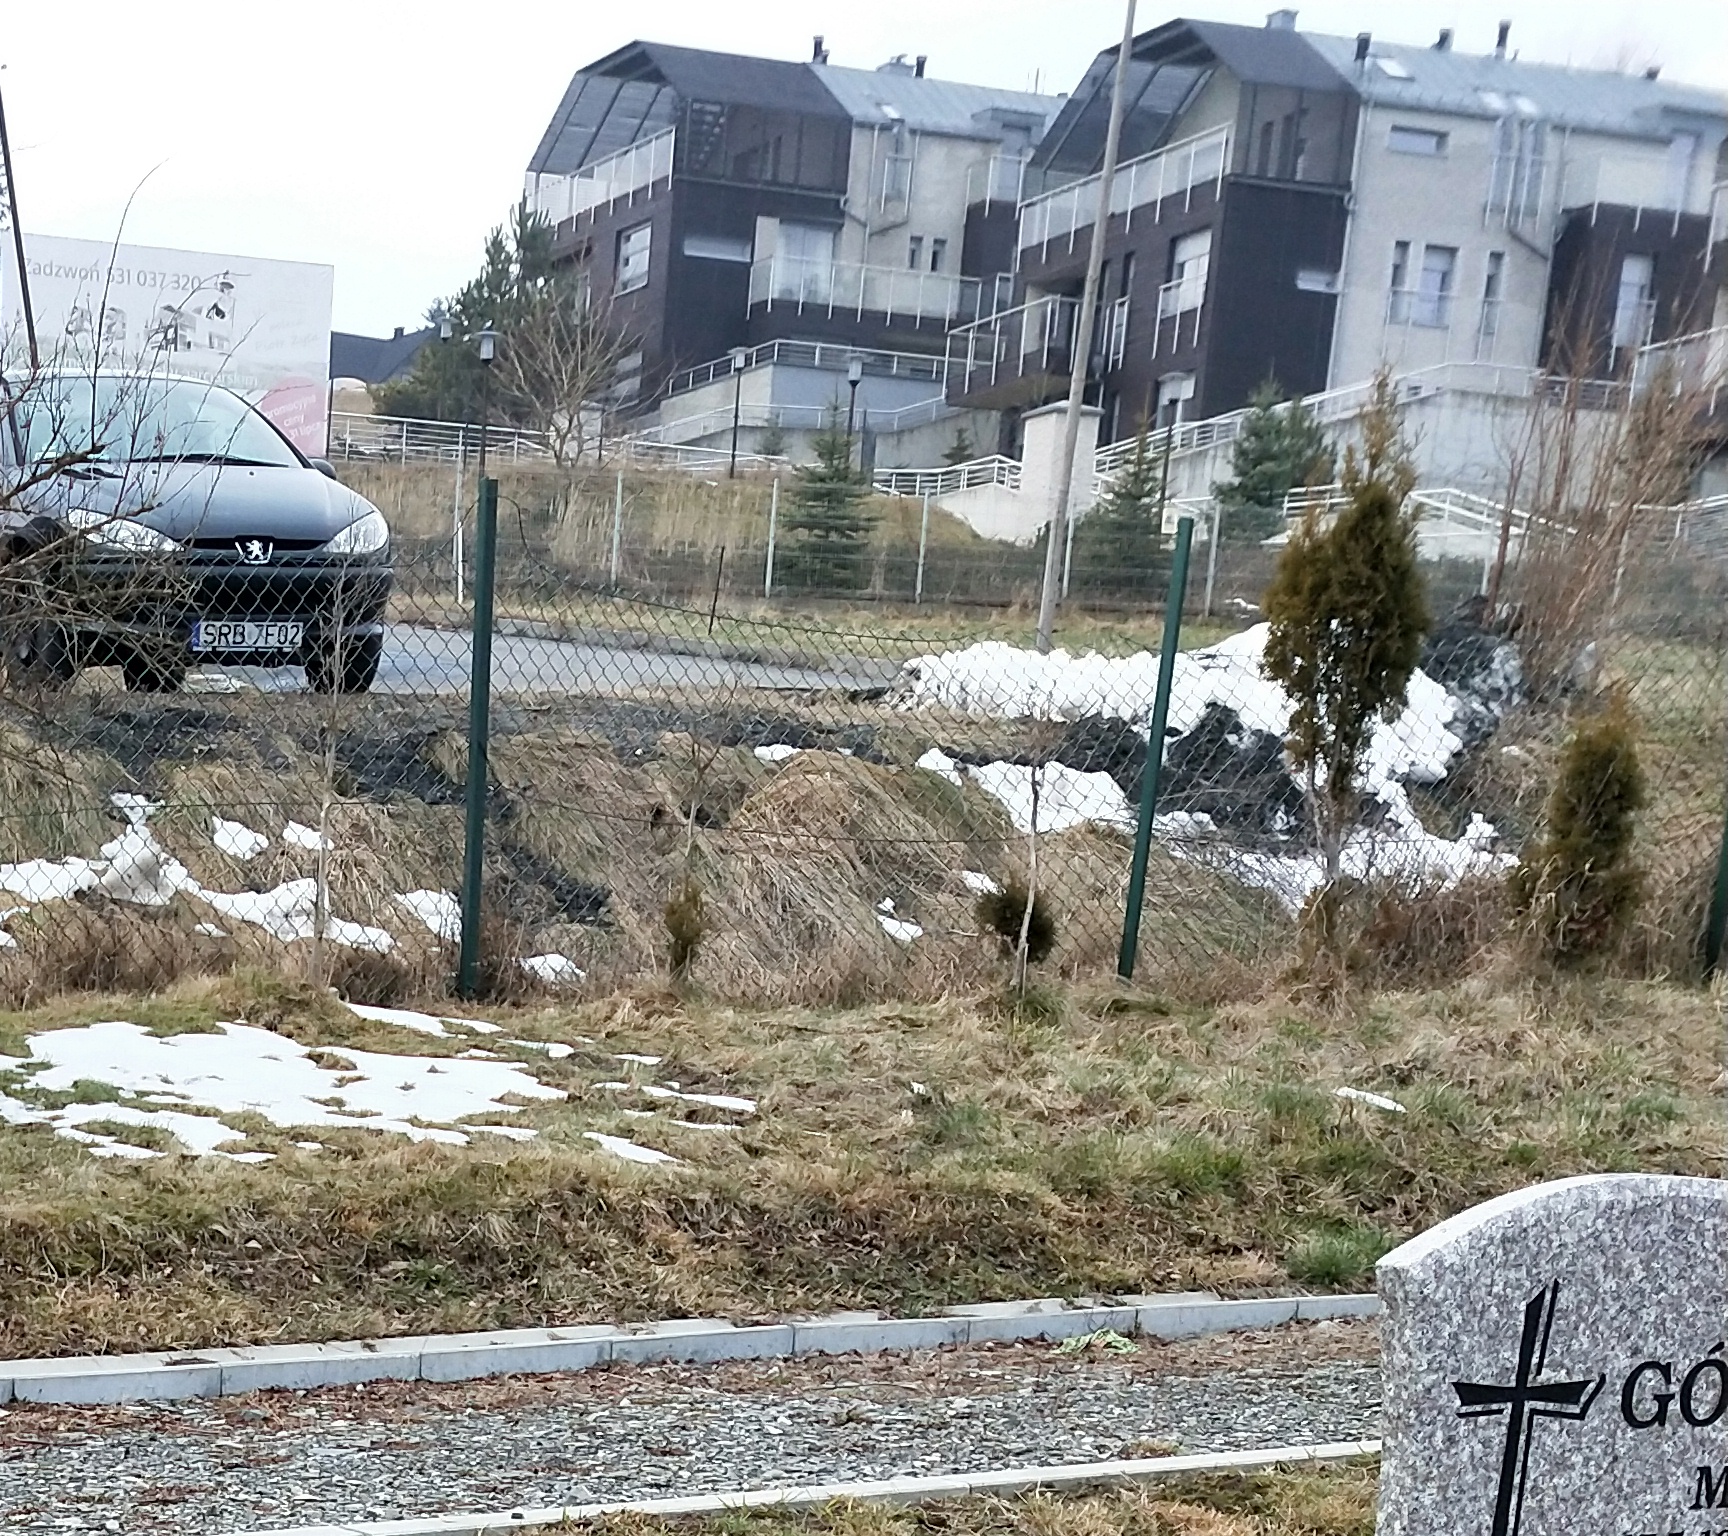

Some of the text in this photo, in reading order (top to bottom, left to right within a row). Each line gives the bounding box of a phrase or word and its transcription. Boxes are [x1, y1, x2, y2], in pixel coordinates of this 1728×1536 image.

[137, 269, 166, 289] 037
[172, 274, 202, 291] 320
[203, 623, 246, 646] SRB
